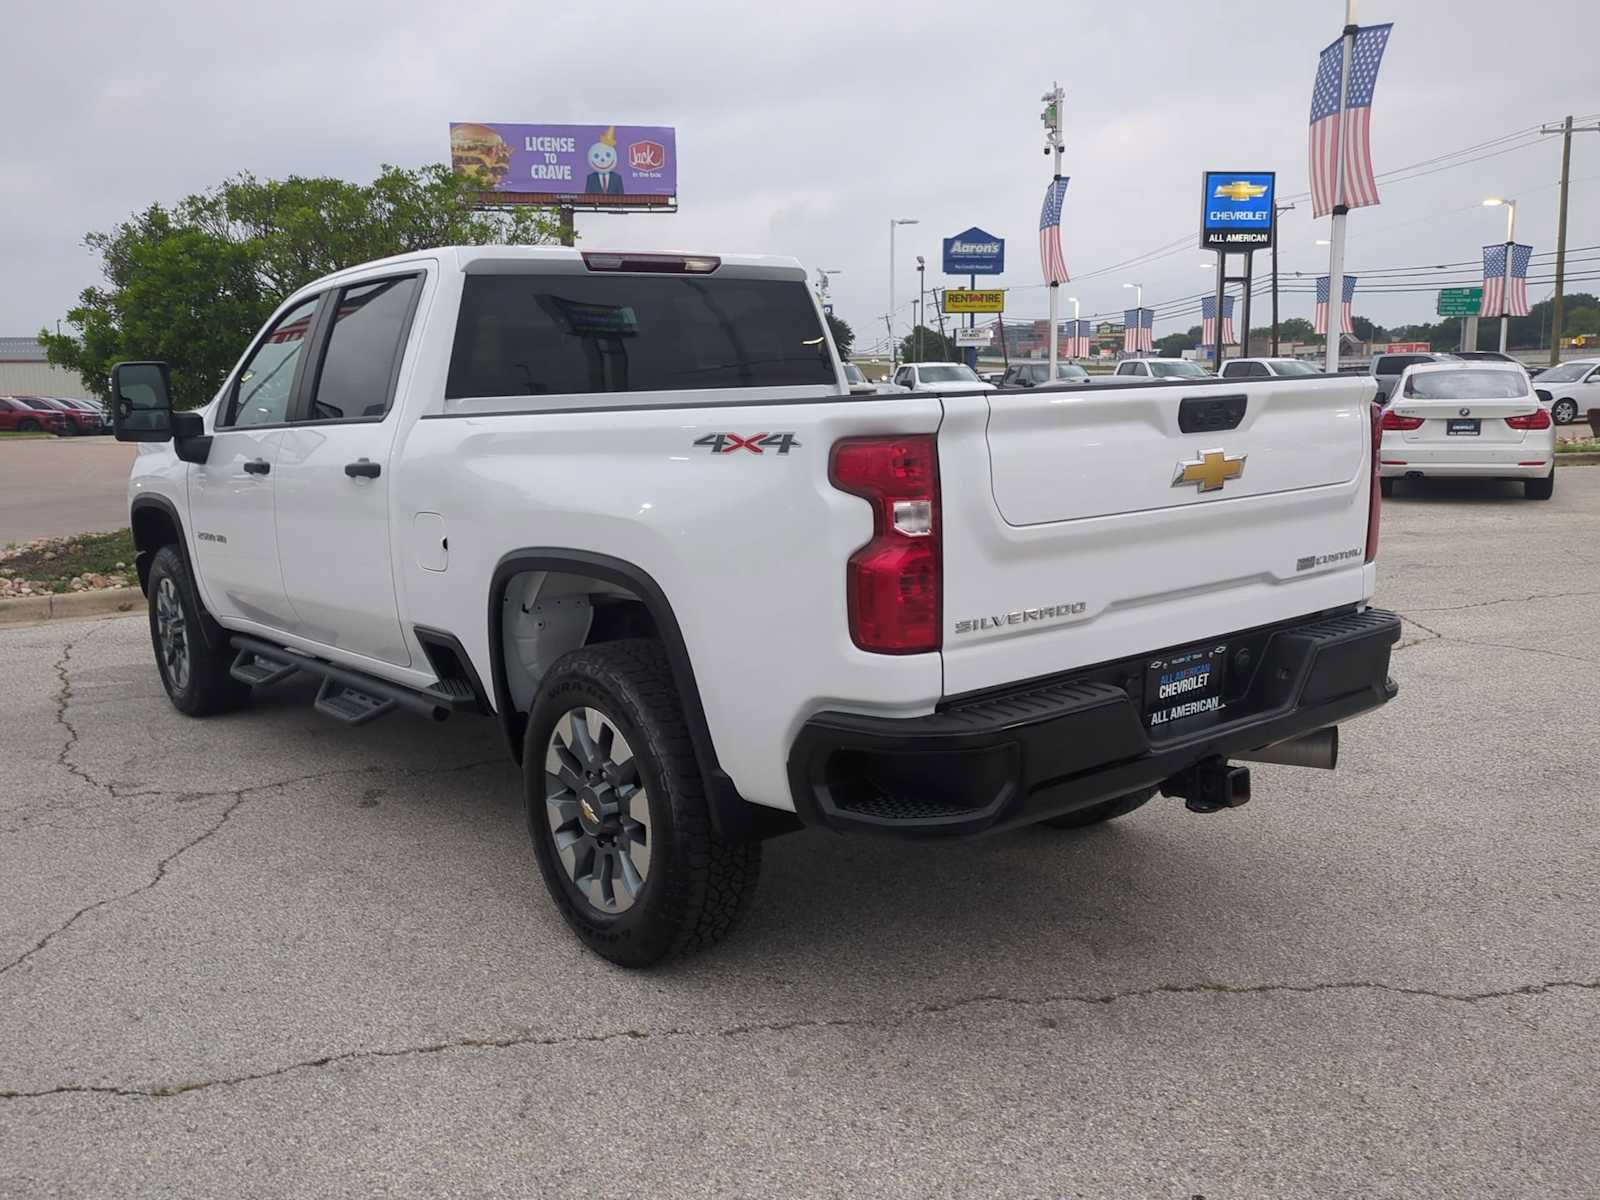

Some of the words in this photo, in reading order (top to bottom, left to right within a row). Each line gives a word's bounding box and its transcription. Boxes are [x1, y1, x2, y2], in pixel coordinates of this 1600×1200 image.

[525, 137, 575, 152] LICENSE
[544, 153, 557, 165] TO
[631, 144, 661, 166] Jack
[530, 164, 572, 180] CRAVE
[1210, 211, 1268, 221] CHEVROLET
[1208, 234, 1225, 242] ALL
[1226, 233, 1268, 242] AMERICAN
[951, 240, 1000, 255] Aaron's
[955, 602, 1087, 634] SILVERADO
[1159, 673, 1210, 699] CHEVROLET
[1151, 709, 1169, 726] ALL
[1169, 696, 1220, 720] AMERICAN
